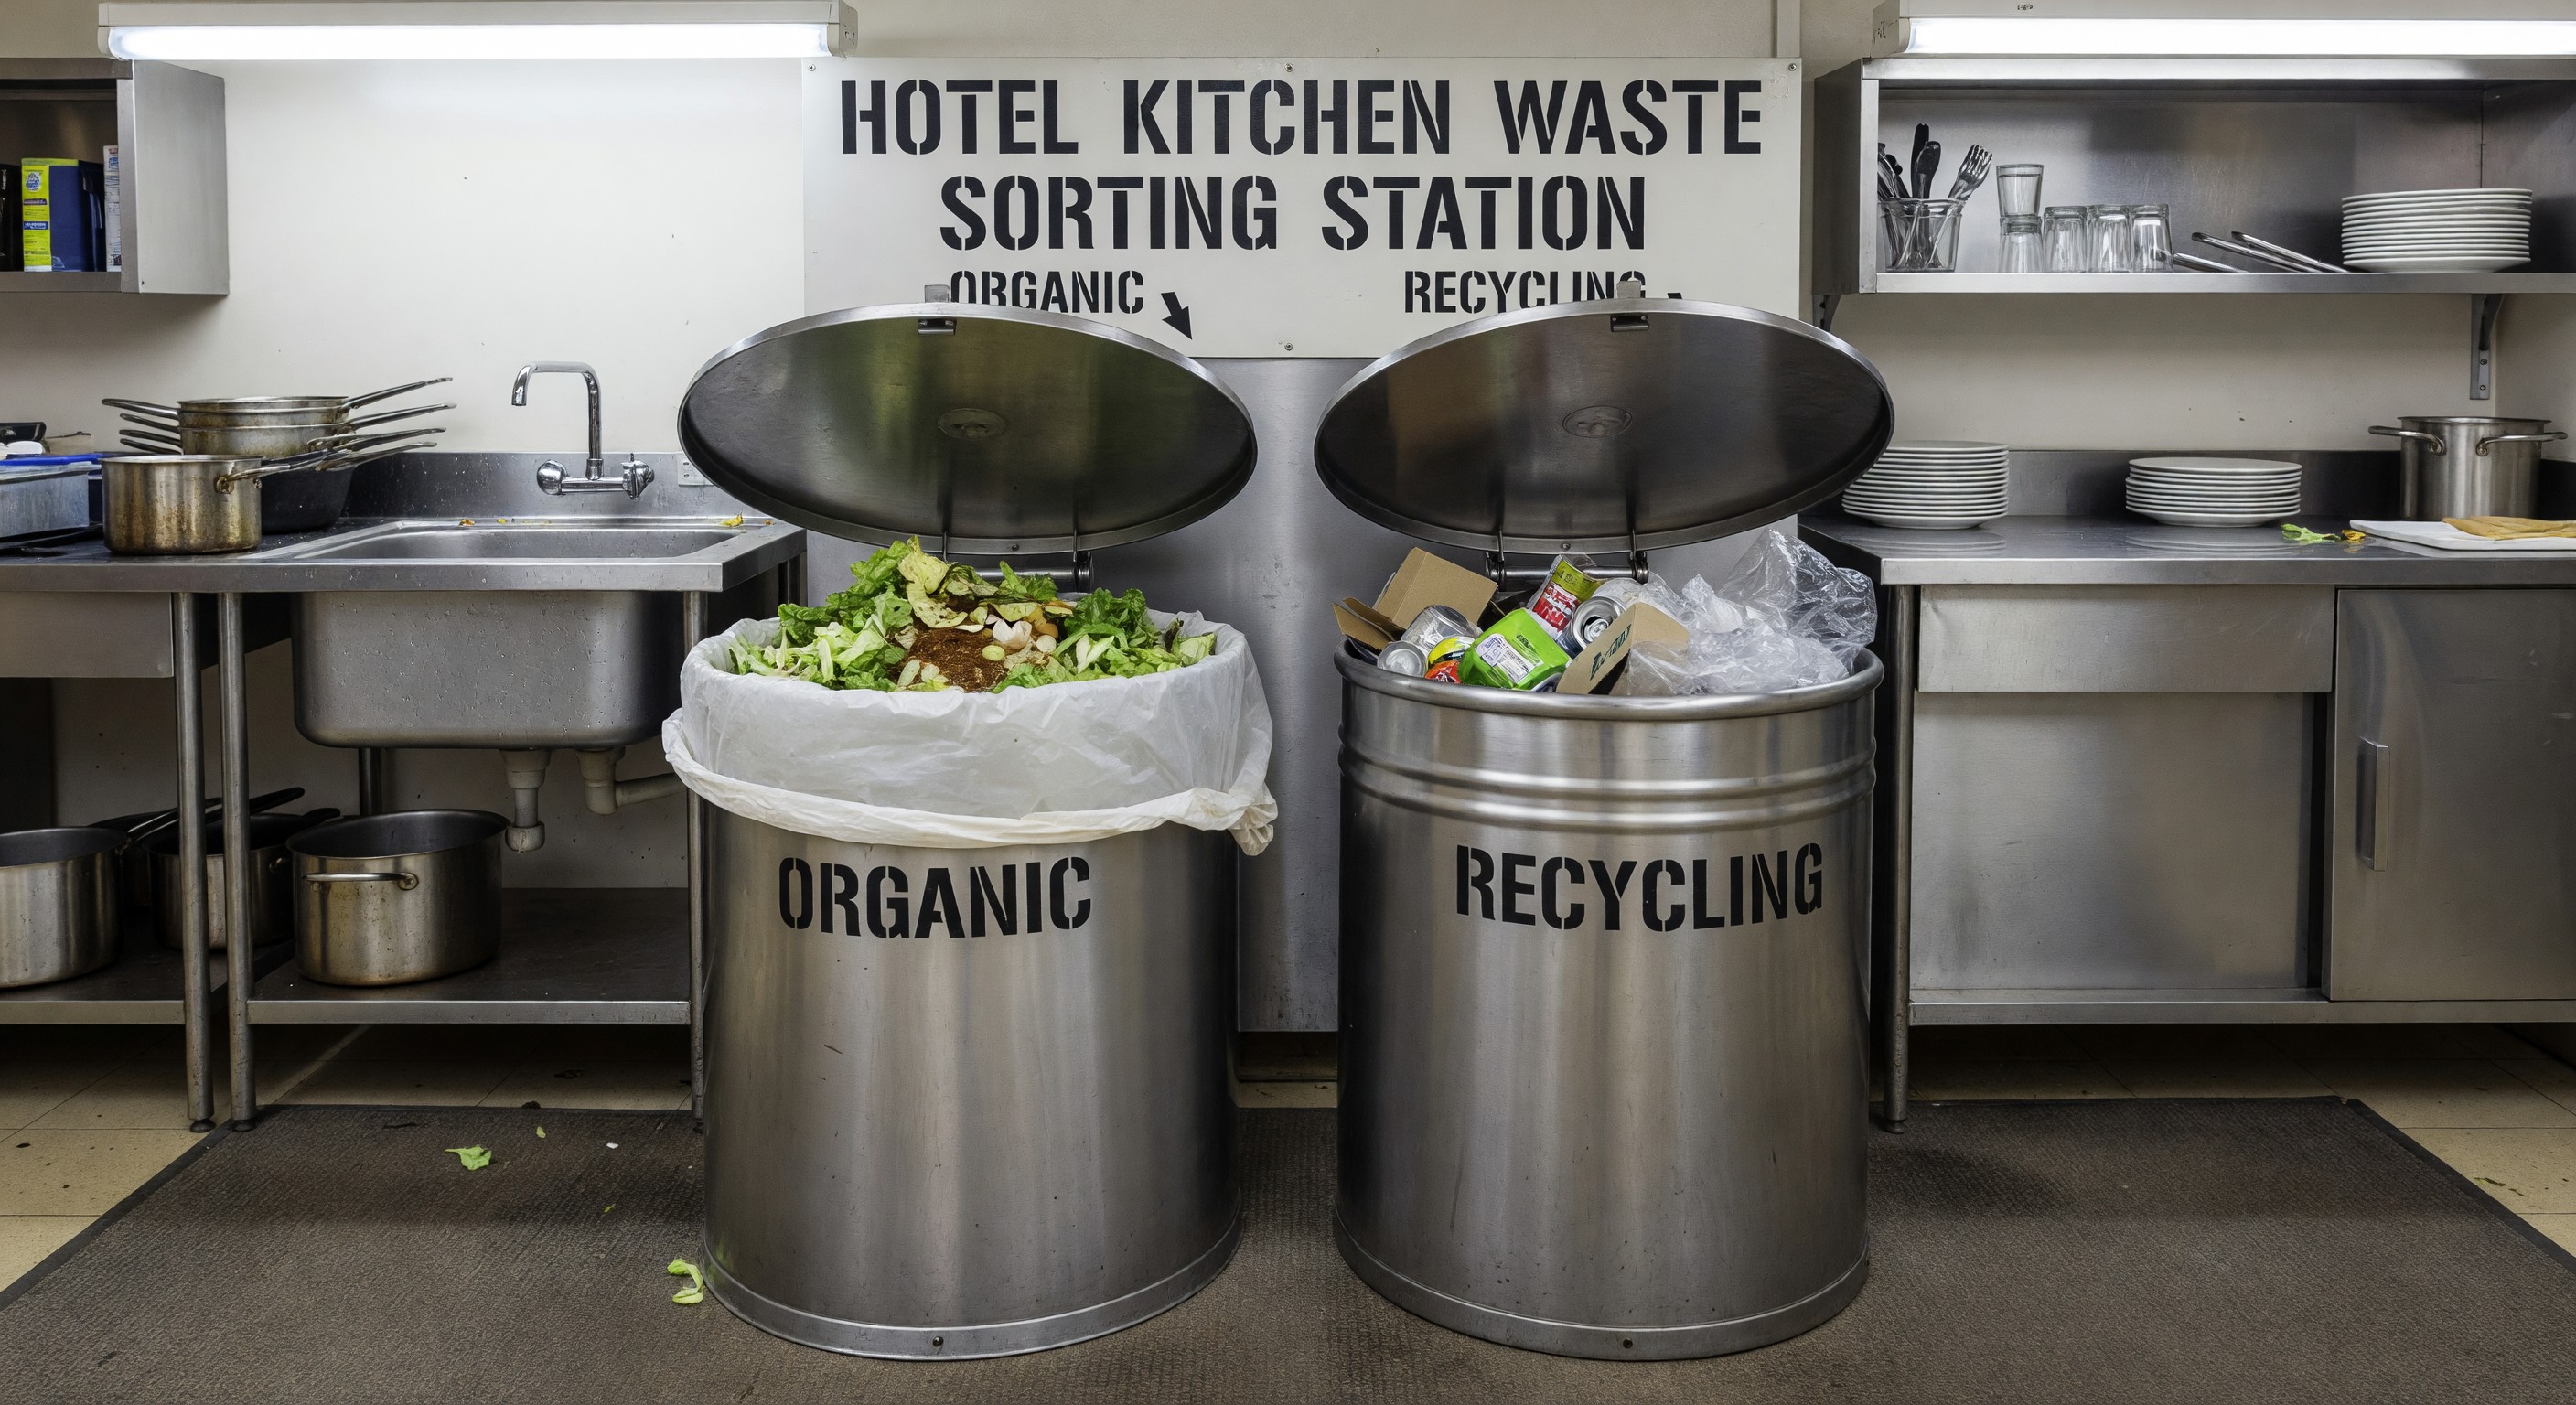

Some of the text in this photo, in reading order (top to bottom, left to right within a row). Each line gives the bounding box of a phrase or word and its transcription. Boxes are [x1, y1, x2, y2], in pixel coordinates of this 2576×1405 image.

[841, 80, 1762, 155] HOTEL KITCHEN WASTE
[939, 175, 1645, 251] SORTING STATION
[950, 270, 1144, 314] ORGANIC
[778, 856, 1091, 939] ORGANIC
[1456, 842, 1823, 932] RECYCLING
